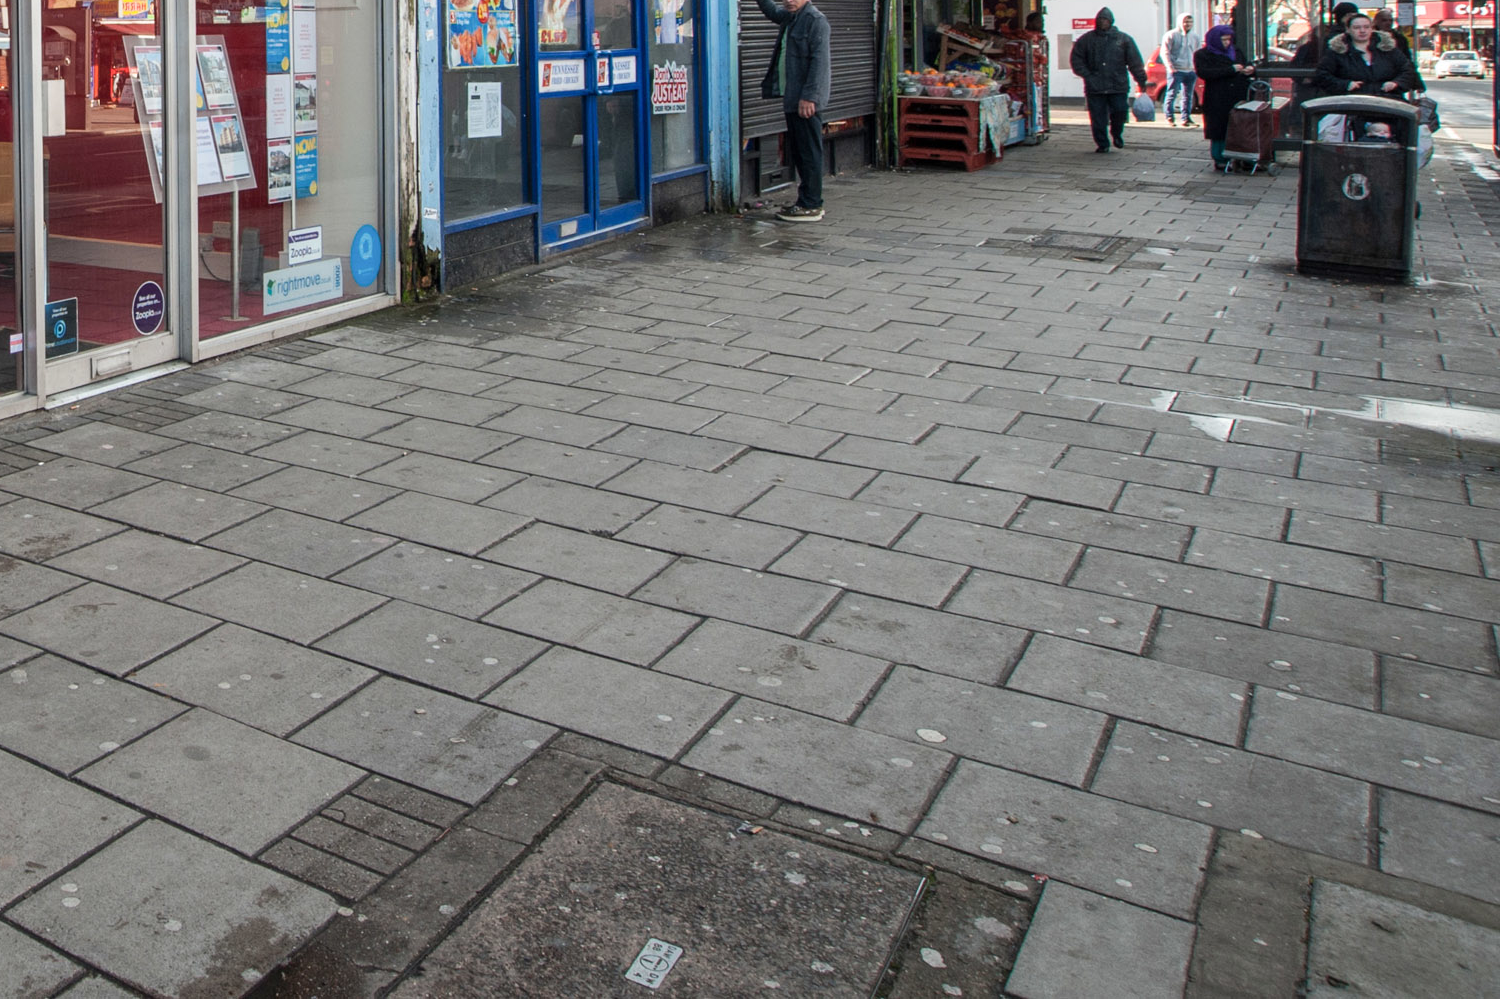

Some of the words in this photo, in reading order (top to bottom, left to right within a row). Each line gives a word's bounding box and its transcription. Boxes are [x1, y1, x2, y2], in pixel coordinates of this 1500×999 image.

[266, 12, 289, 29] NOW!
[551, 64, 580, 76] TENNESSEE
[653, 83, 673, 104] JUST
[673, 82, 688, 103] EAT
[295, 136, 317, 156] NOW!
